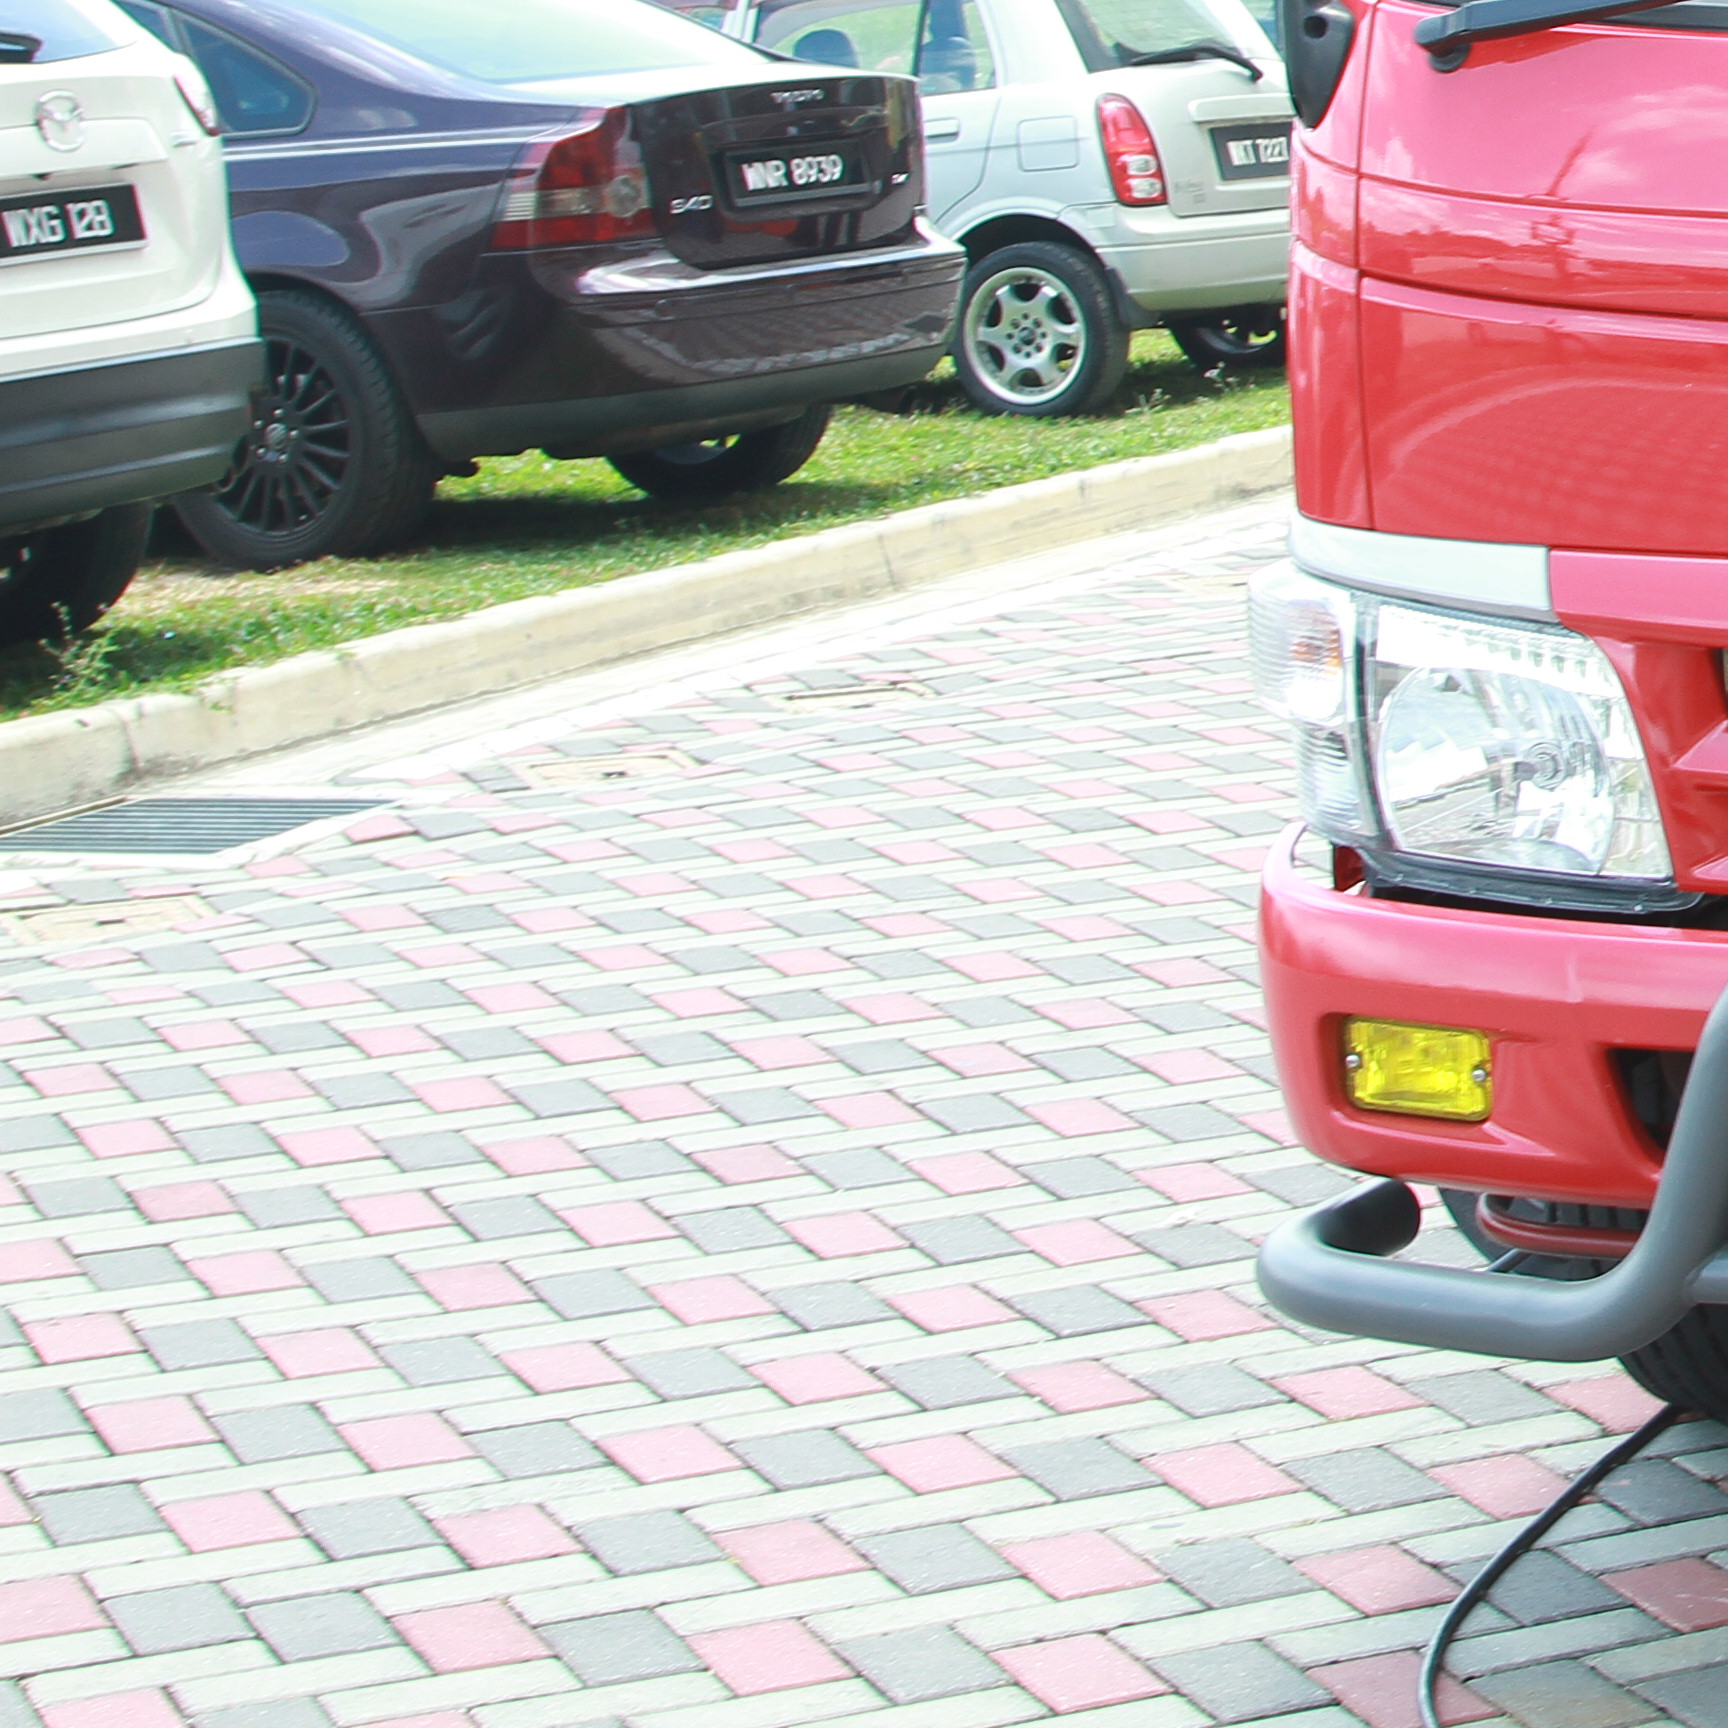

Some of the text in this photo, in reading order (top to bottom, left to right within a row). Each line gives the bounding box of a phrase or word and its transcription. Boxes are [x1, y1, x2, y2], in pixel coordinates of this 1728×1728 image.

[741, 154, 843, 191] WNR 8939
[669, 194, 714, 214] S40
[1, 199, 115, 248] WXG 128
